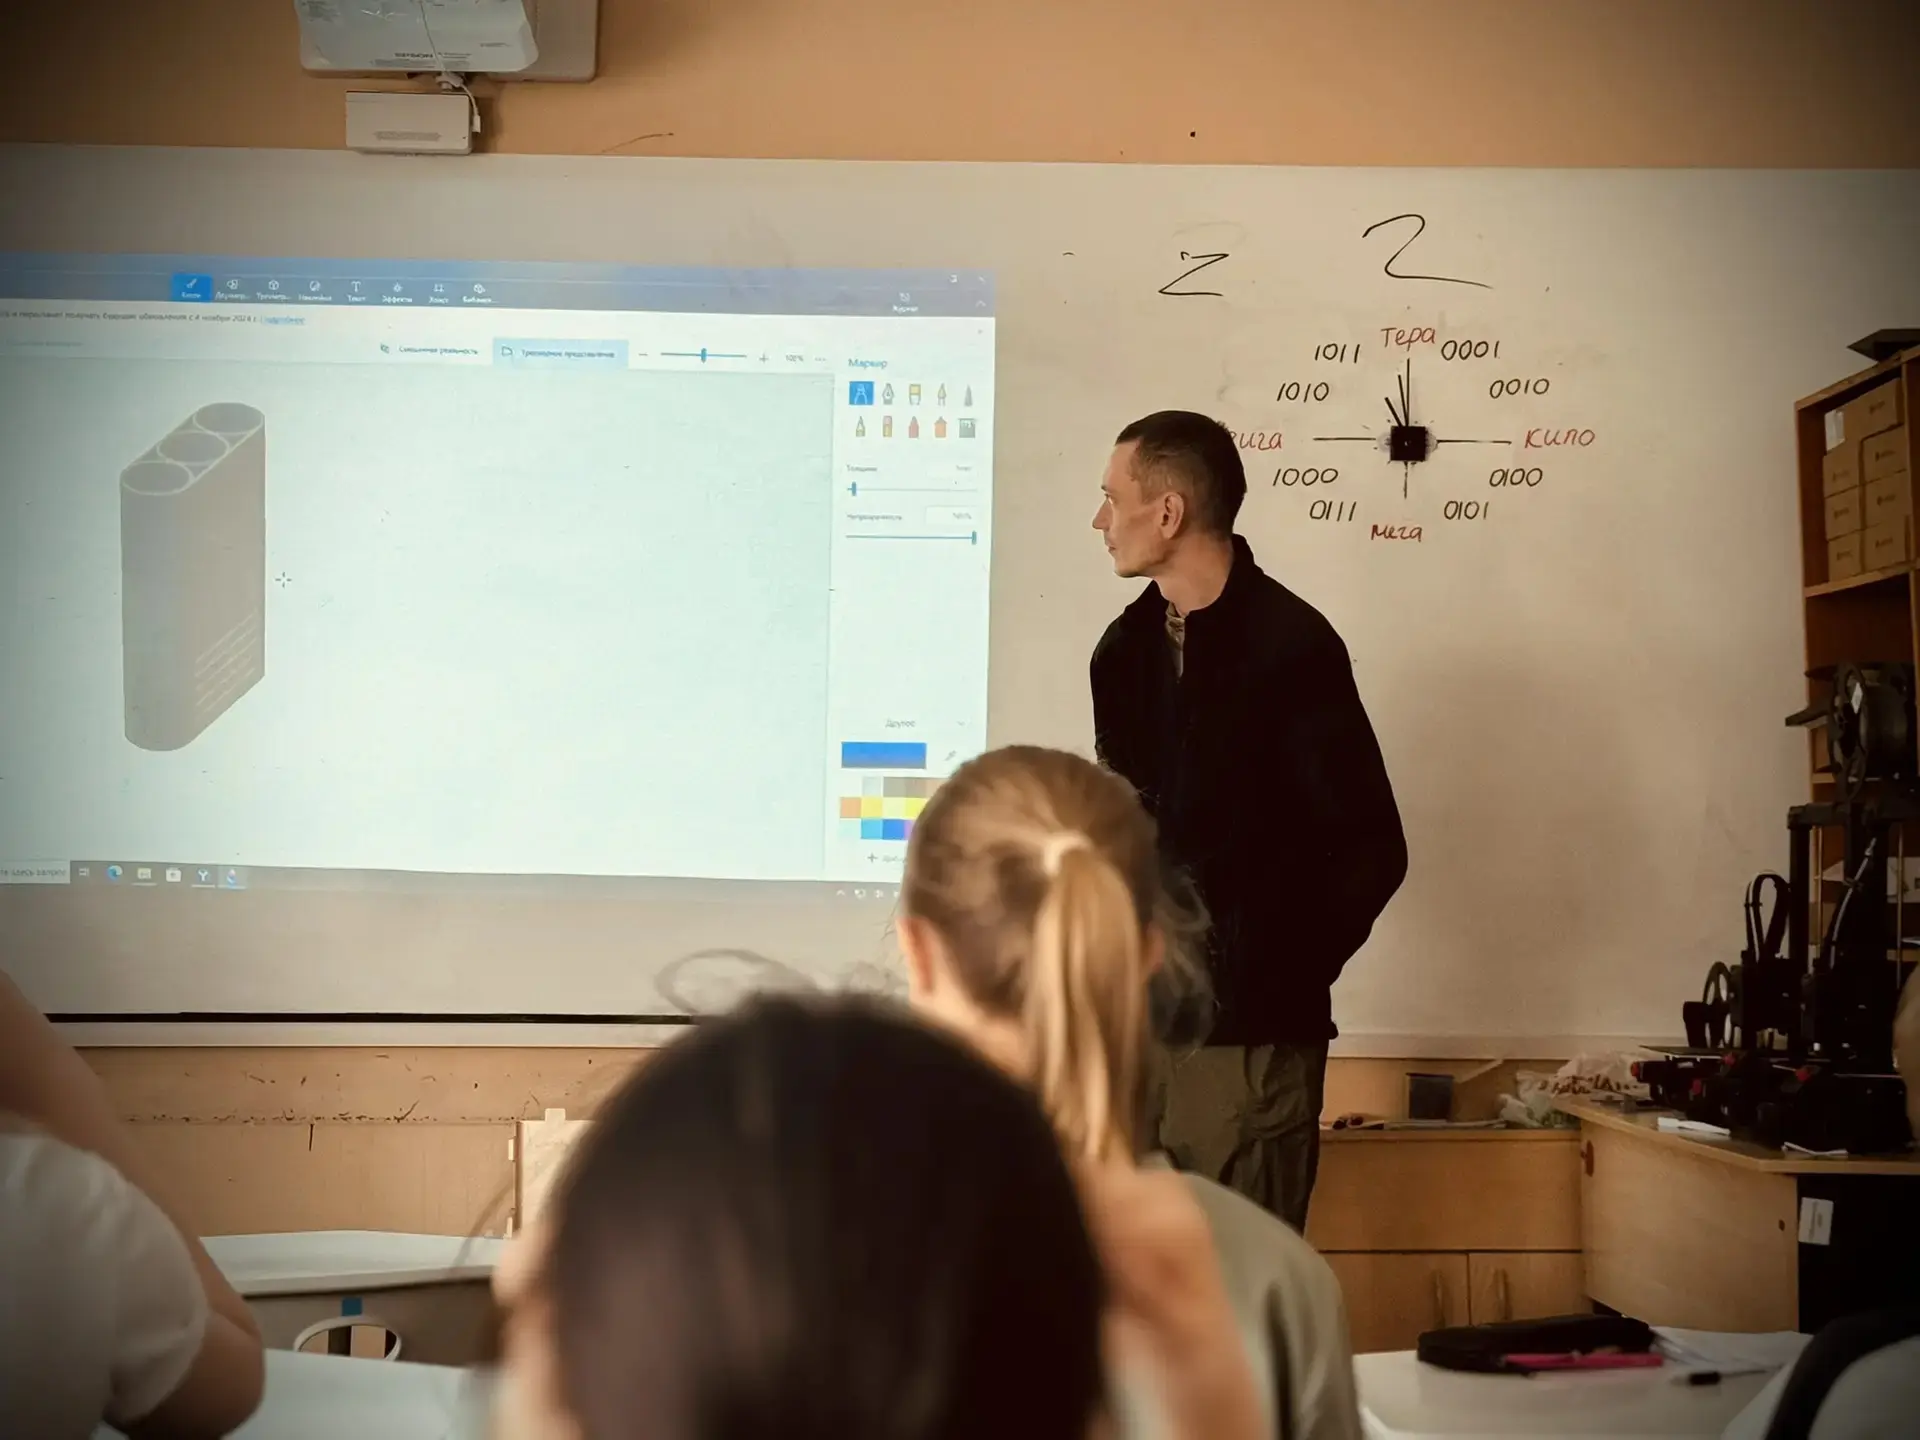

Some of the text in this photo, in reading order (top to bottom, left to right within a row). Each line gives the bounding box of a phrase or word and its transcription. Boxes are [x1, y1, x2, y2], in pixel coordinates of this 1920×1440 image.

[1314, 342, 1361, 364] 1011
[1440, 339, 1500, 361] 0001
[1276, 380, 1330, 404] 1010
[1489, 377, 1550, 400] 0010
[1272, 467, 1339, 487] 1000
[1488, 467, 1544, 488] 0100
[1308, 499, 1357, 522] 0111
[1443, 500, 1489, 521] 0101
